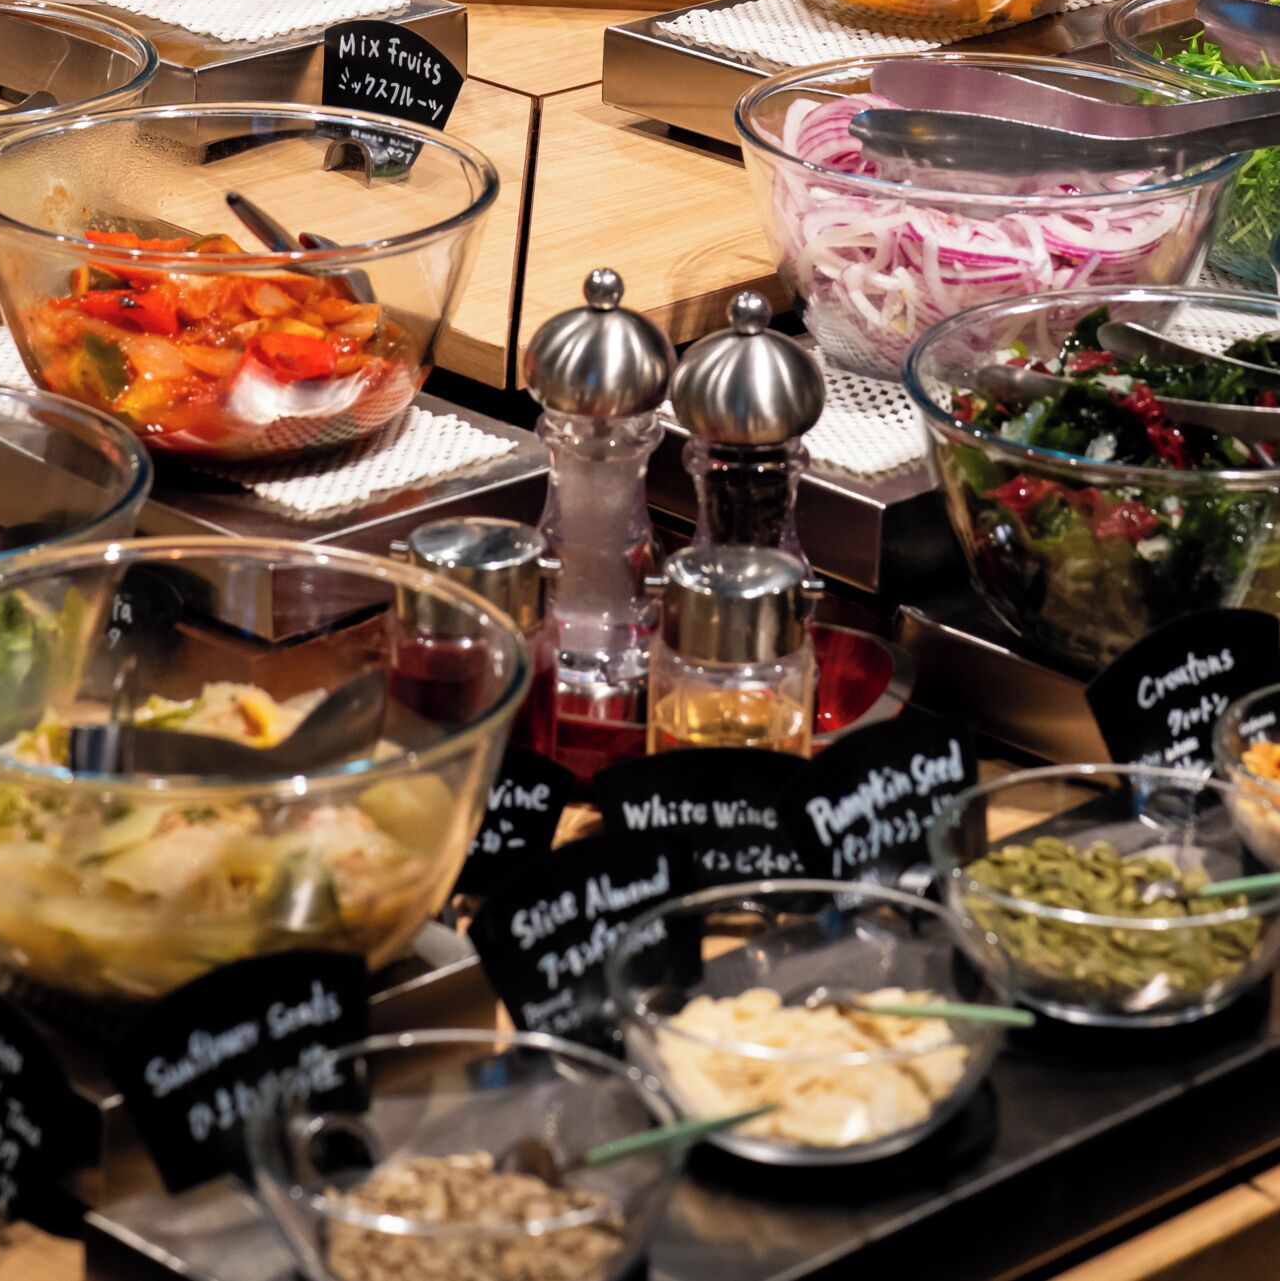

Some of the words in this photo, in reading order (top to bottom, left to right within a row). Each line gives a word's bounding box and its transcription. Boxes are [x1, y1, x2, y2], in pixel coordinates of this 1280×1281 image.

[338, 32, 381, 60] Mix
[387, 37, 442, 86] Fruits
[338, 66, 444, 121] ミックスフルーツ
[623, 793, 709, 831] White
[712, 799, 779, 831] Wine
